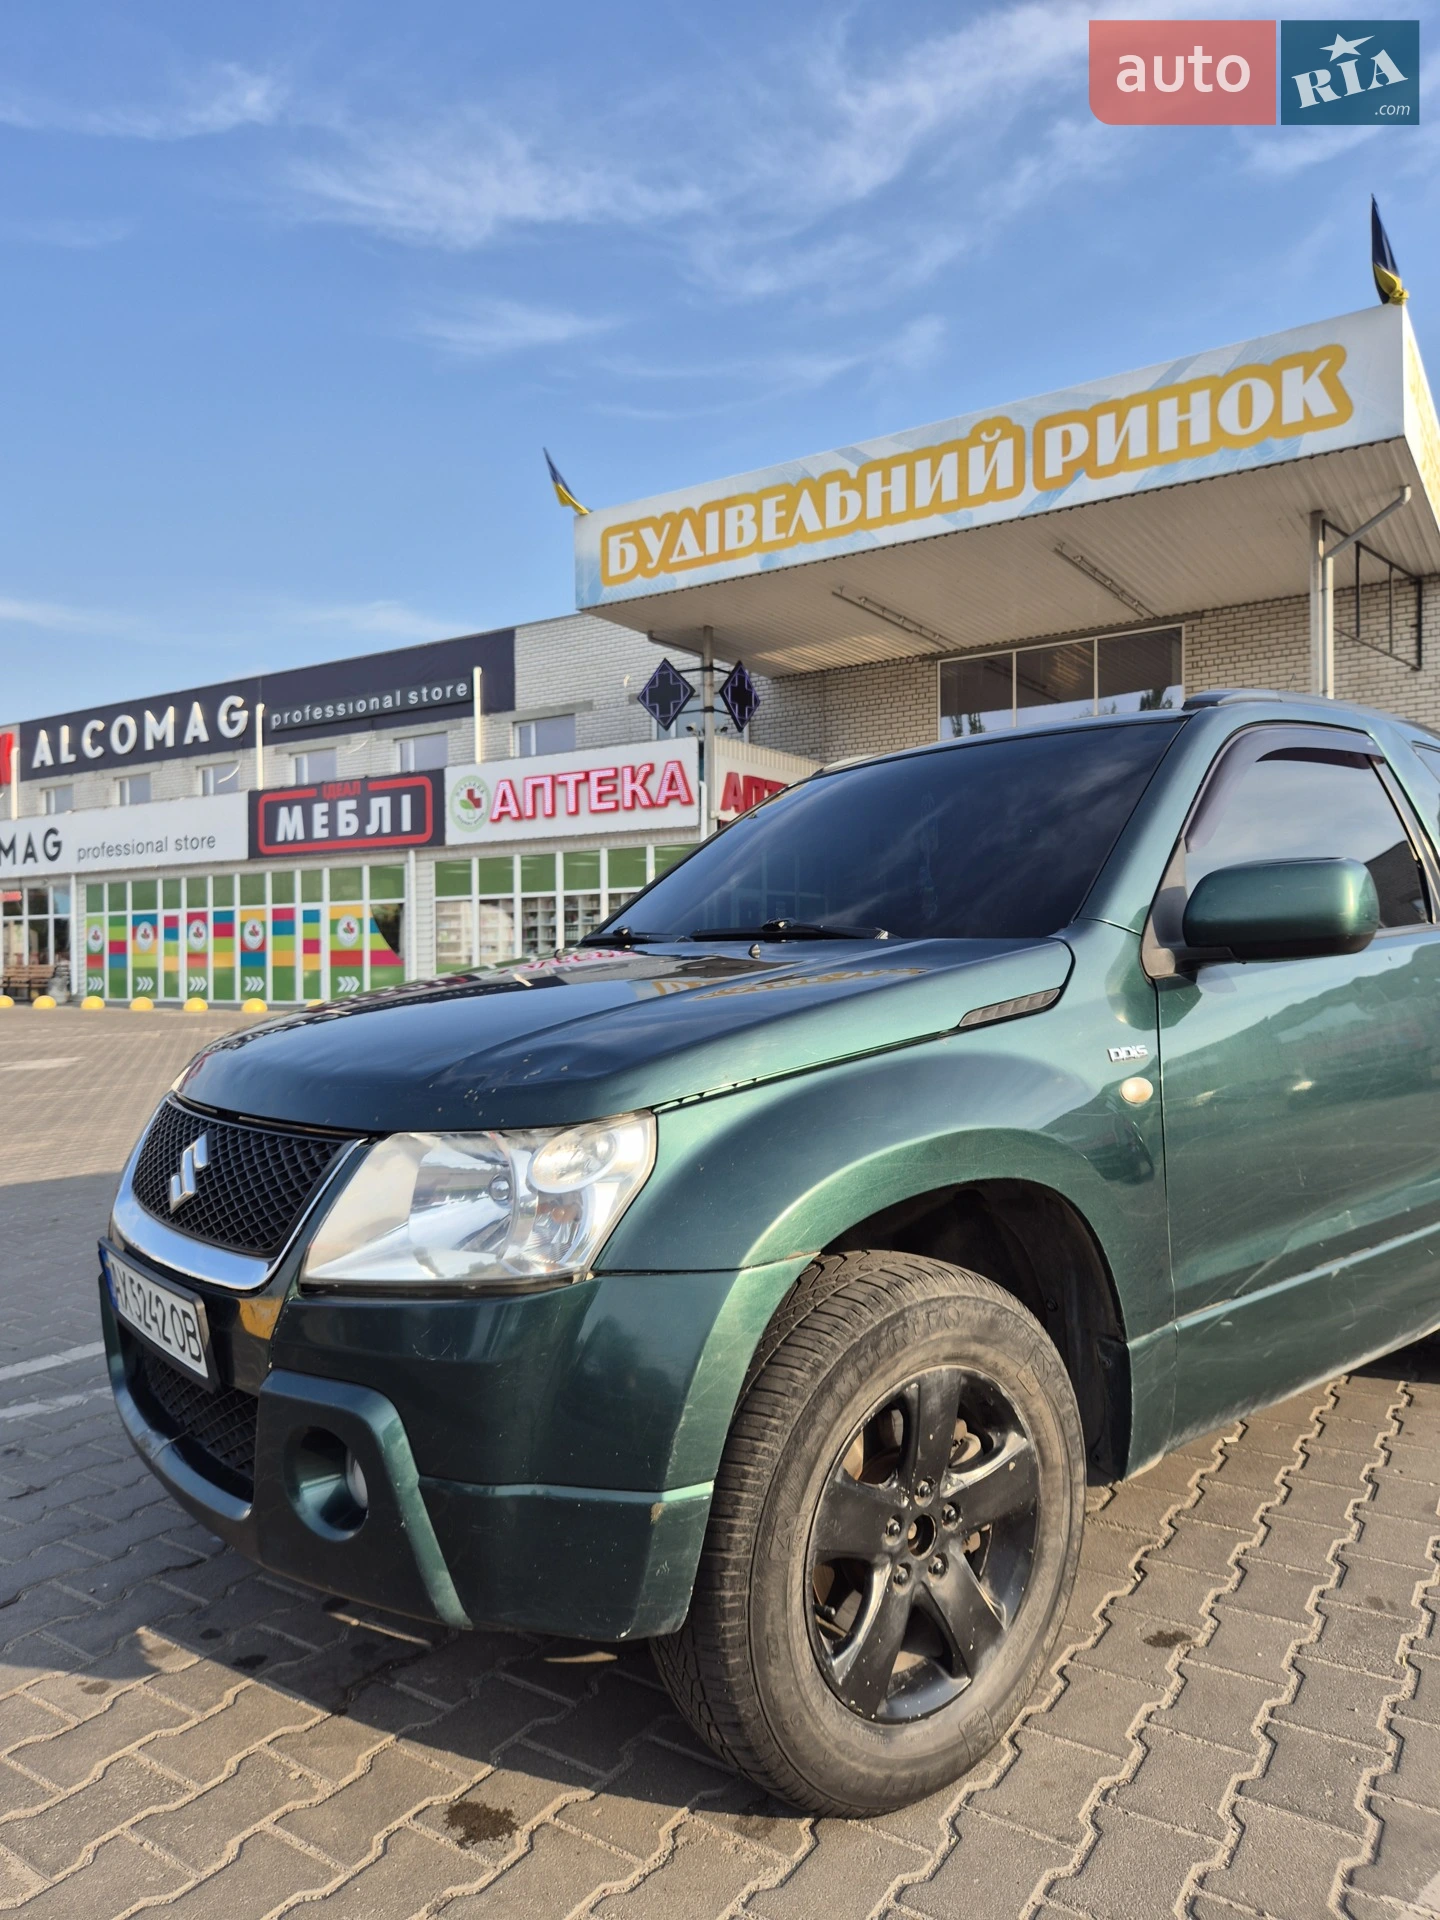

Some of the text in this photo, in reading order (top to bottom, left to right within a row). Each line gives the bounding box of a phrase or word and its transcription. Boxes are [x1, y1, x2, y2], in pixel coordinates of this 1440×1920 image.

[608, 358, 1338, 577] БУДІВЕЛЬНИЙ РИНОК
[31, 694, 249, 769] ALCOMAG
[270, 690, 401, 730] professional
[408, 682, 468, 705] store
[276, 794, 411, 841] МЕБЛІ
[489, 760, 695, 823] АПТЕКА
[77, 836, 168, 862] professional
[174, 834, 217, 852] store
